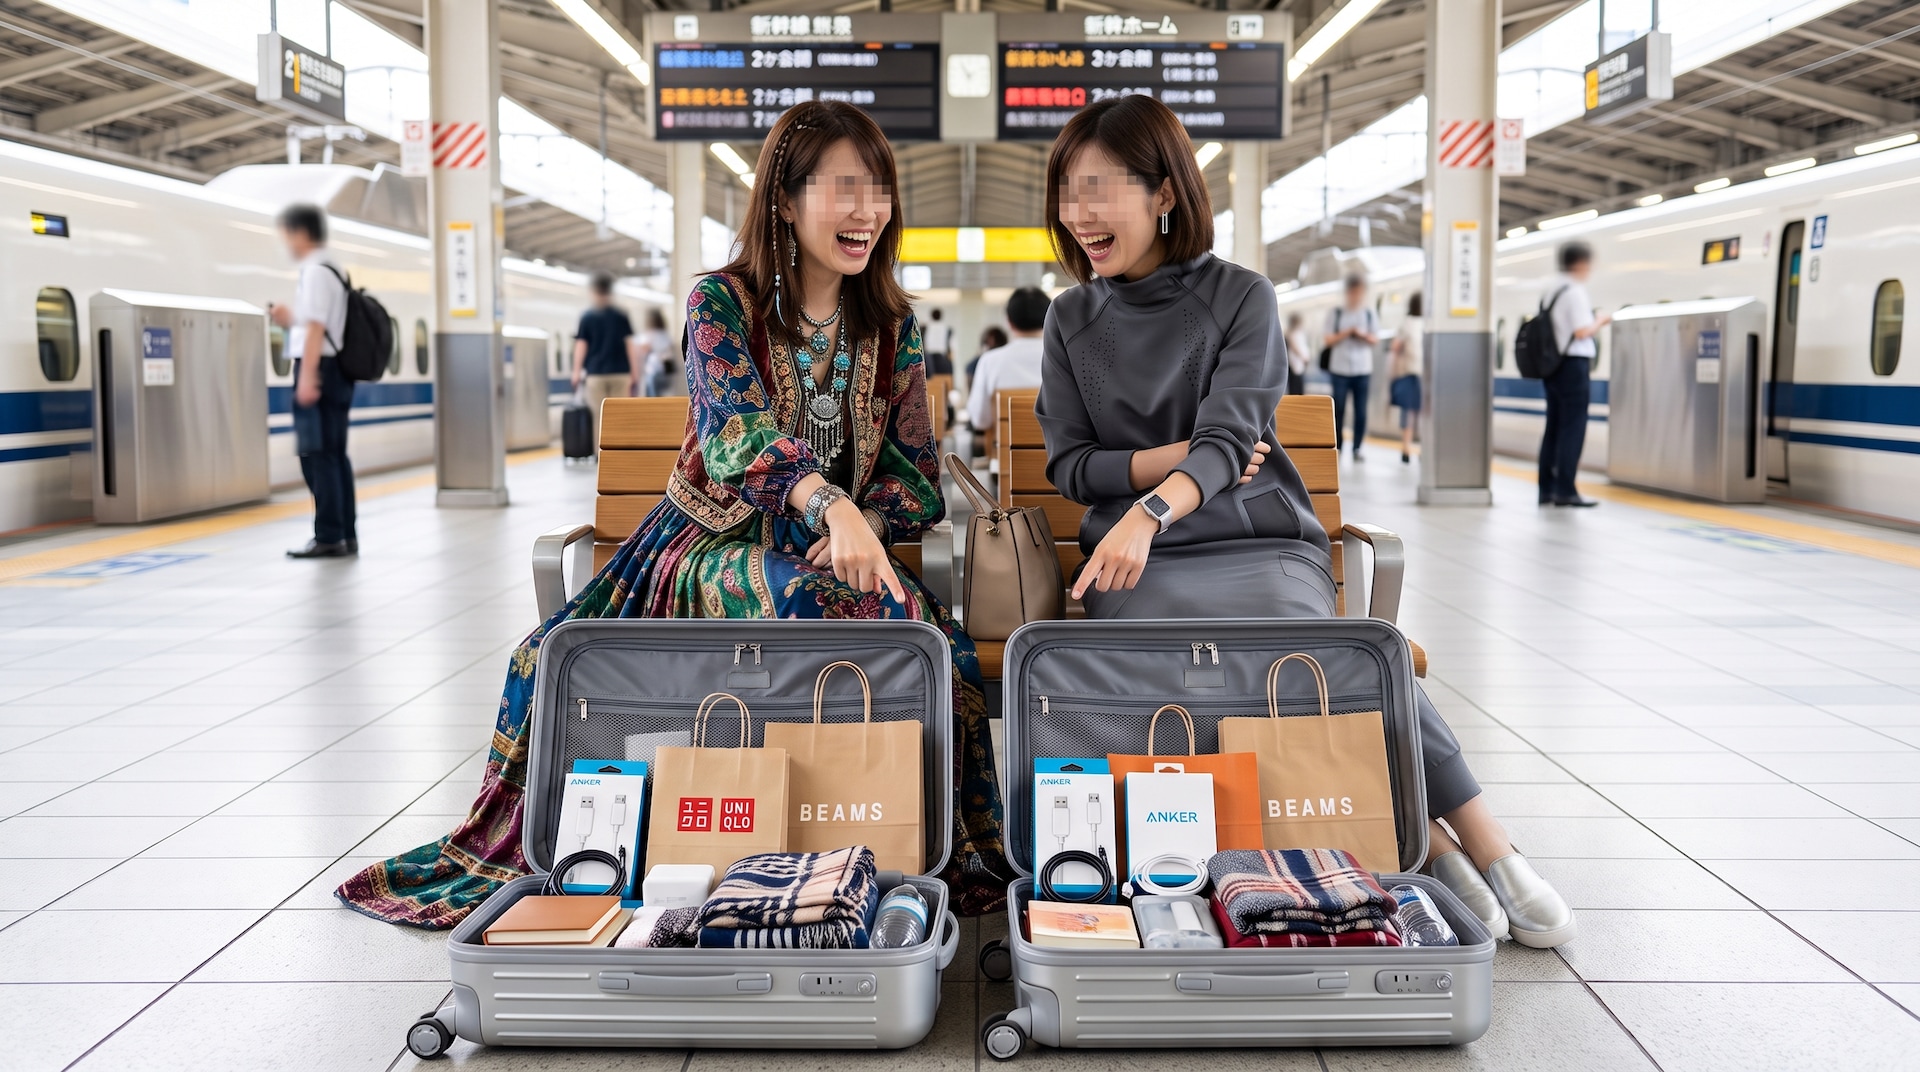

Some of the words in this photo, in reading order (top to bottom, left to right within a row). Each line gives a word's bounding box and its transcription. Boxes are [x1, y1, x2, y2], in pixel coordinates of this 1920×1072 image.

[682, 801, 708, 813] ユニ
[724, 801, 749, 814] UNI
[800, 802, 883, 822] BEAMS
[1267, 796, 1354, 818] BEAMS
[681, 815, 707, 828] クロ
[723, 816, 751, 831] QLO
[1146, 811, 1198, 823] ANKER
